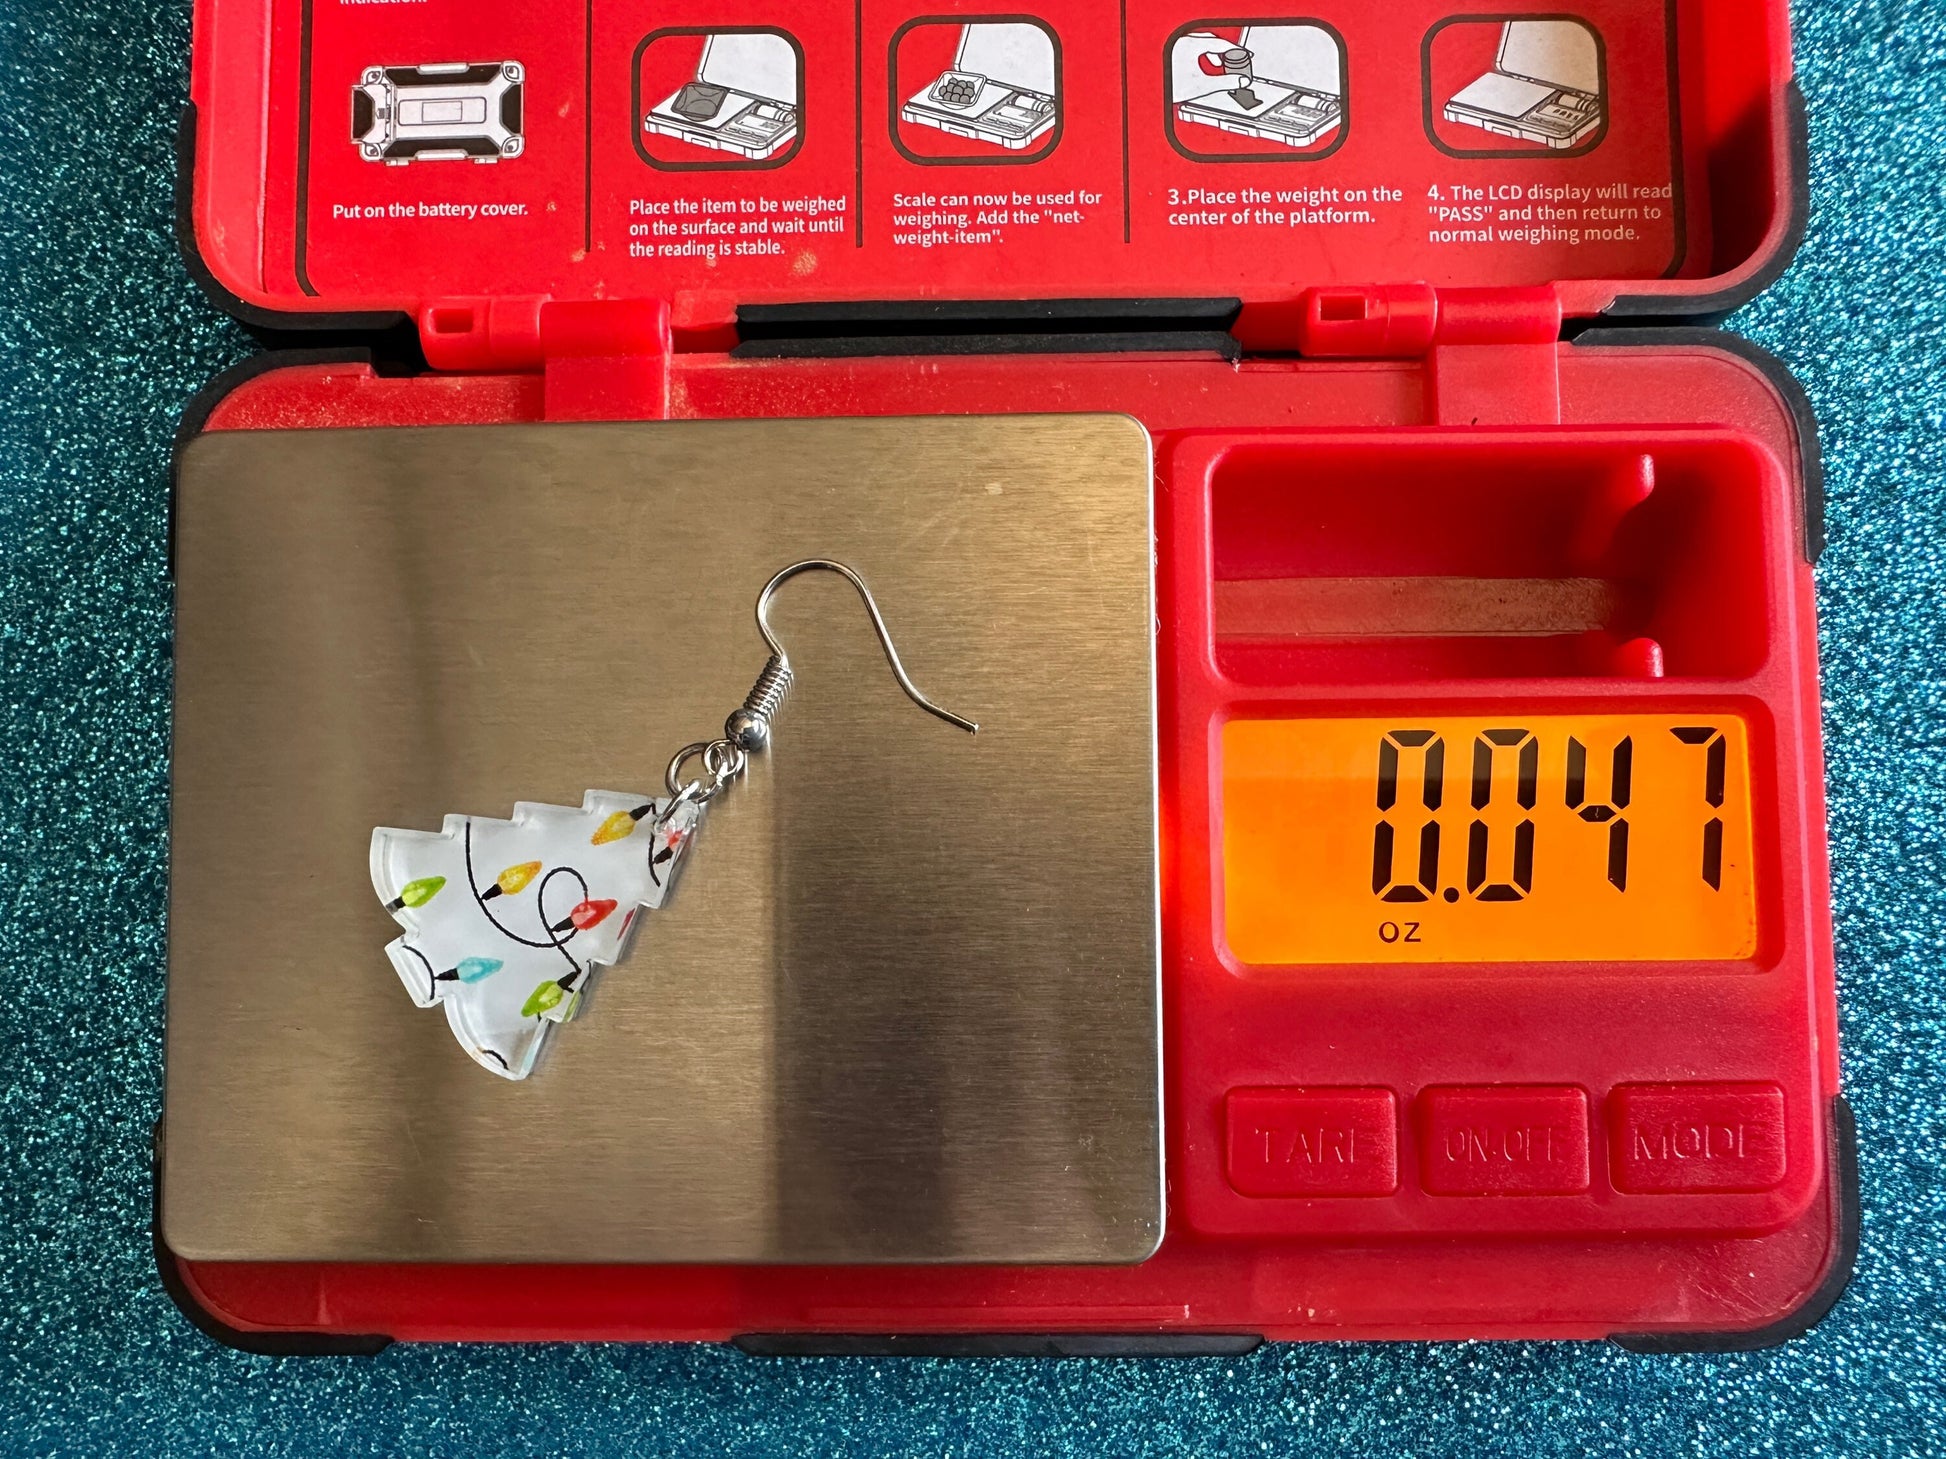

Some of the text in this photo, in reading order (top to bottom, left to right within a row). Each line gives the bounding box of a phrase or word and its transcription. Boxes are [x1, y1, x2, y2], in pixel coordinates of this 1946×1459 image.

[893, 189, 1104, 207] Scale can now be used for
[1240, 187, 1273, 204] the
[1276, 186, 1341, 207] weight
[1344, 190, 1369, 203] on
[1371, 185, 1404, 202] the
[1427, 182, 1674, 204] 4. The LCD display will read
[334, 201, 529, 220] Put on the battery cover.
[630, 195, 847, 216] Place the item to be weighed
[1428, 204, 1663, 223] "PASS" and then return to
[629, 216, 845, 236] on the surface and wait until
[893, 208, 1086, 230] weighing. Add the "net-
[1168, 206, 1377, 228] center of the platform.
[893, 228, 1005, 248] weight-item".
[1428, 224, 1641, 245] normal weighing mode.
[629, 238, 786, 259] the reading is stable.
[1371, 726, 1727, 903] 0.047
[1632, 1123, 1766, 1161] MODE
